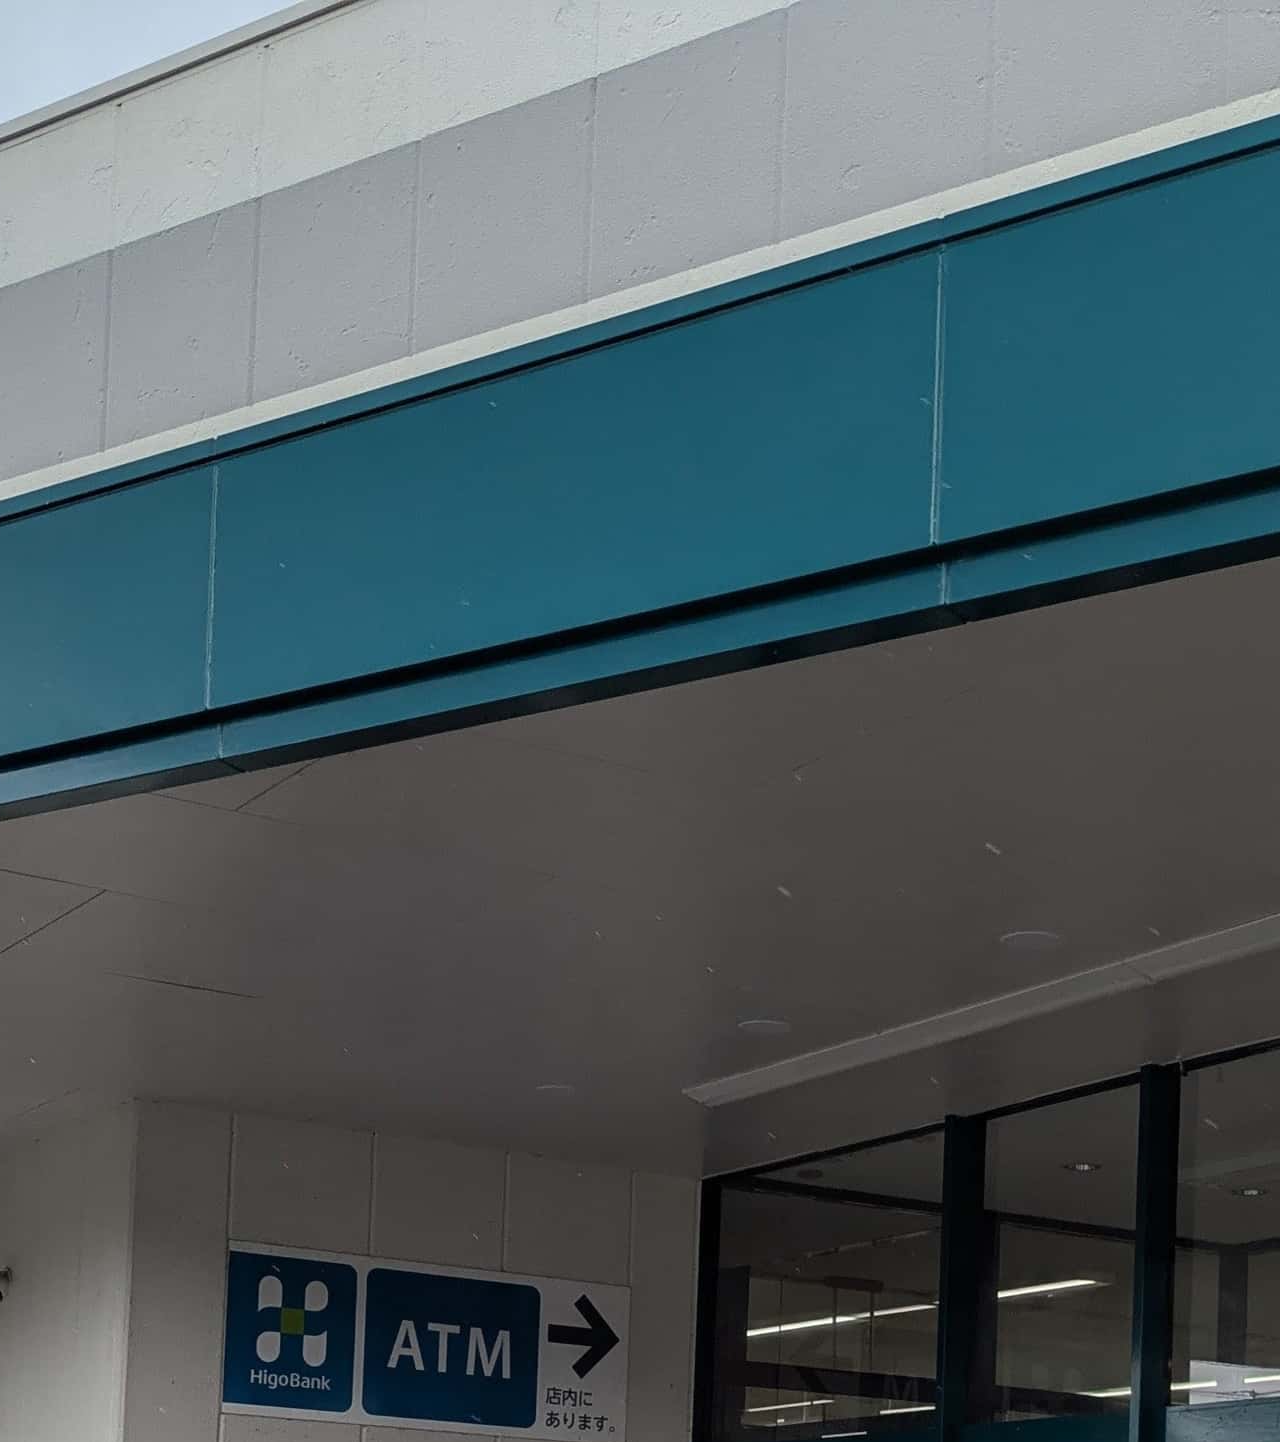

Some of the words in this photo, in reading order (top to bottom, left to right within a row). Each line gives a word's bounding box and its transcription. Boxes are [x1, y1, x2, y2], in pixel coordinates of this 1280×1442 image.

[387, 1319, 511, 1380] ATM
[250, 1369, 332, 1391] HigoBank
[545, 1387, 593, 1408] 店内に
[545, 1411, 617, 1433] あります。
